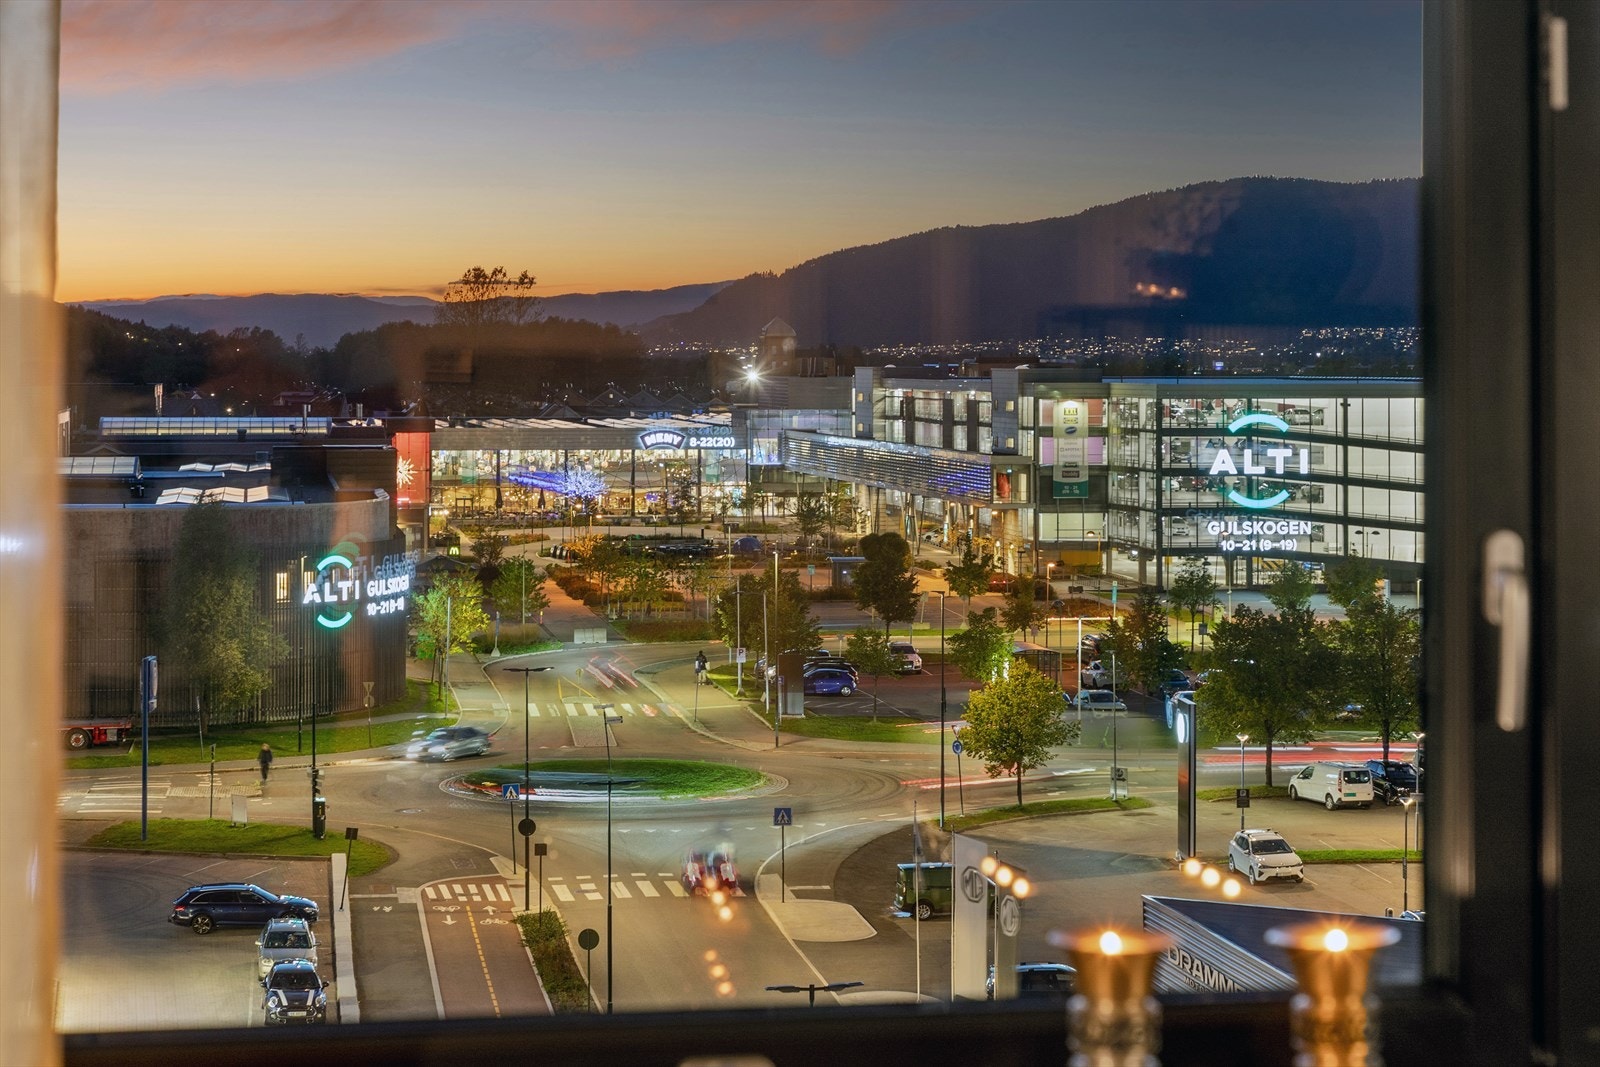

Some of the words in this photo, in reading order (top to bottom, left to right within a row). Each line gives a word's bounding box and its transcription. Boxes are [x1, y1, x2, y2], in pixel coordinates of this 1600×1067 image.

[644, 433, 682, 446] MENY
[1209, 448, 1309, 475] ALTI
[1207, 521, 1312, 536] GULSKOGEN
[302, 580, 360, 604] ALTI
